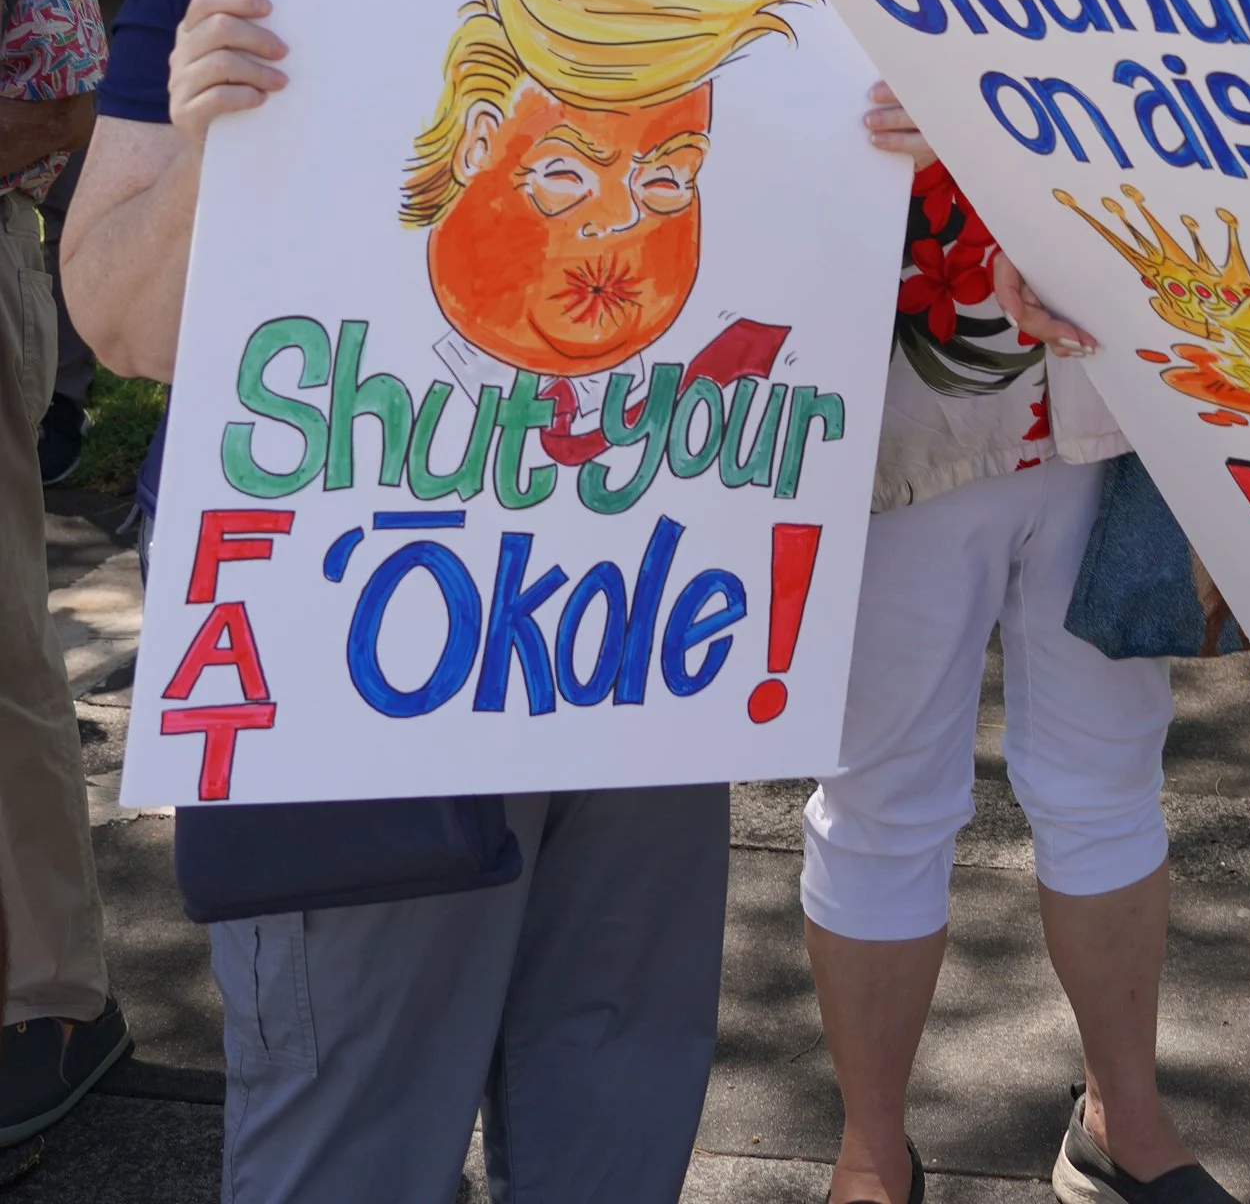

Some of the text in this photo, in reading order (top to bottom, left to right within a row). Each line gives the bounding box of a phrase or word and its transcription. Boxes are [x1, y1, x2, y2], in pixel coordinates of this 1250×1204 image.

[979, 70, 1133, 170] on
[221, 315, 844, 514] Shut your
[161, 510, 295, 801] FAT
